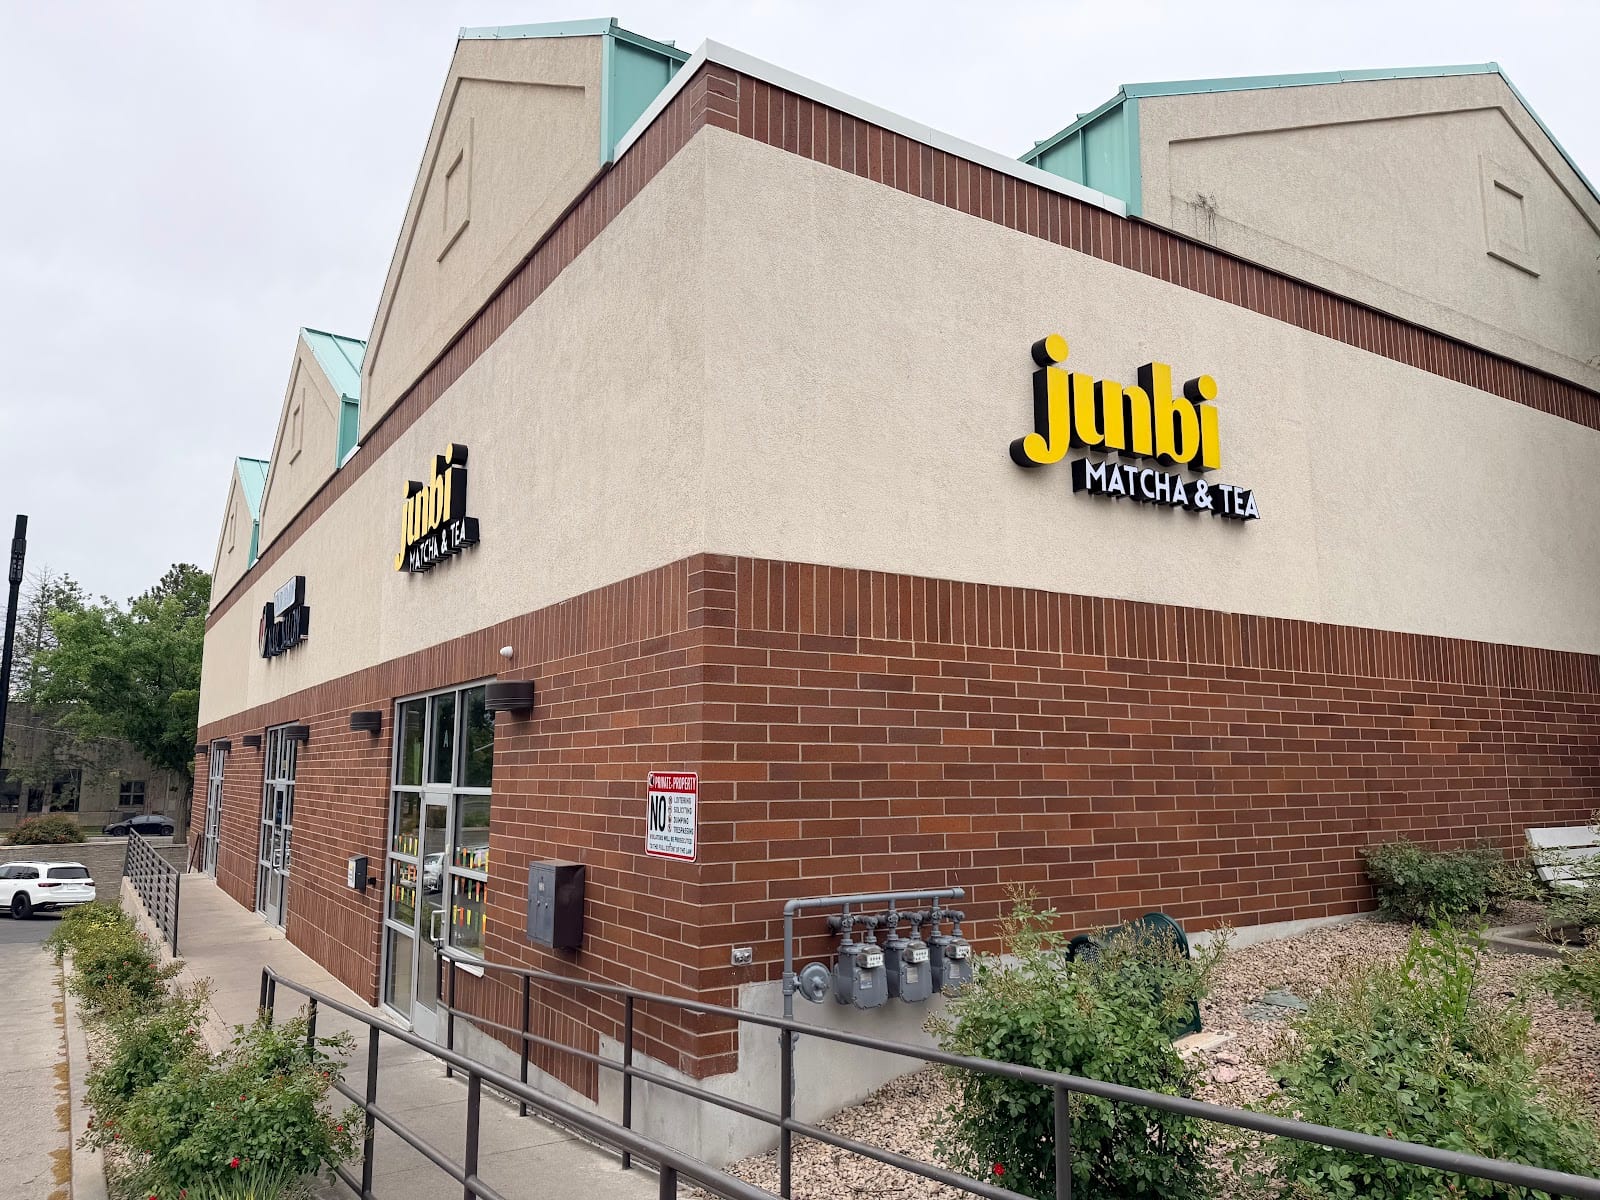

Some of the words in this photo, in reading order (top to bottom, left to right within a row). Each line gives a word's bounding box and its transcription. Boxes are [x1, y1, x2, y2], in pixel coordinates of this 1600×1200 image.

[1022, 333, 1221, 470] junbi
[394, 442, 454, 572] junbi
[1085, 458, 1188, 505] MATCHA
[1194, 479, 1214, 510] &
[1218, 483, 1261, 520] TEA
[409, 535, 439, 573] MATCHA
[440, 528, 448, 554] &
[450, 517, 466, 548] TEA
[654, 776, 672, 789] PRIVATE
[672, 776, 696, 791] PROPERTY
[650, 795, 666, 832] NO
